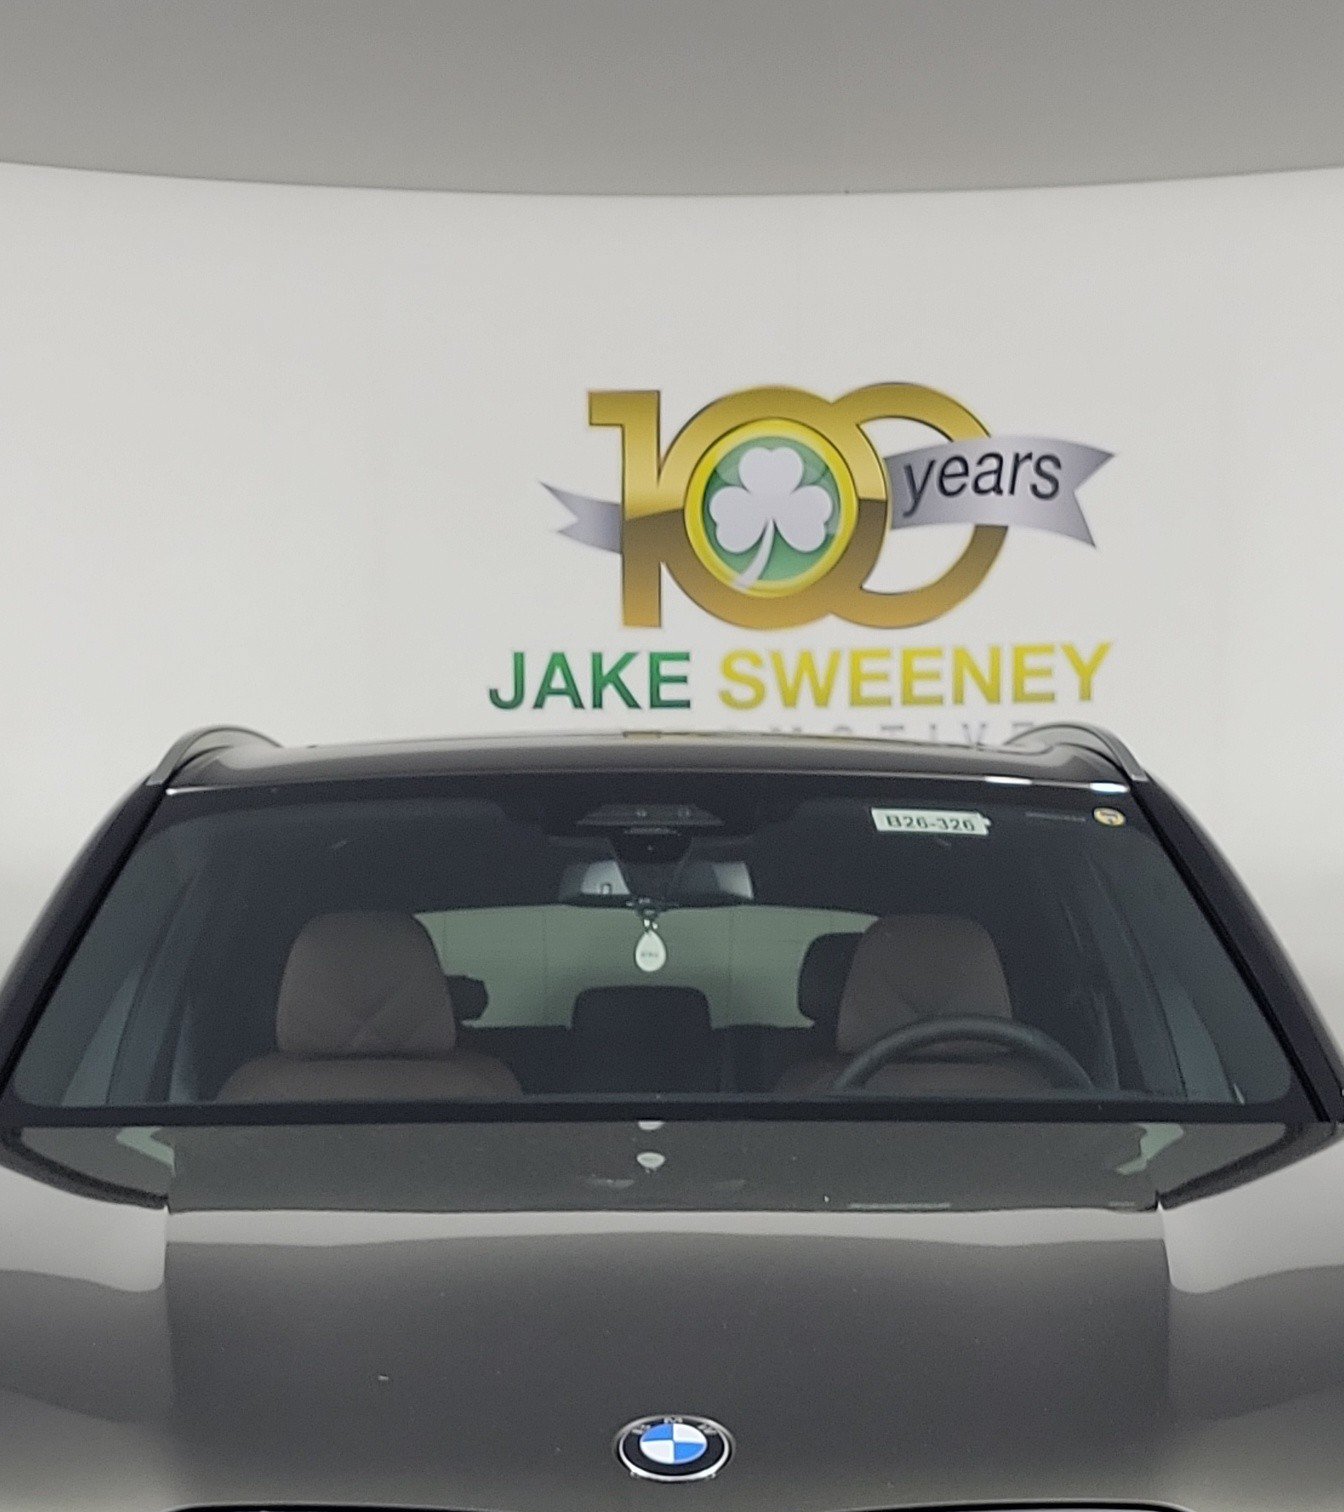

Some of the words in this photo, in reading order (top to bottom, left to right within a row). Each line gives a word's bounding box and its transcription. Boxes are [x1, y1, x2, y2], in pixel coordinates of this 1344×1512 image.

[588, 383, 1008, 630] 100
[903, 450, 1062, 517] years
[488, 651, 691, 710] JAKE
[717, 642, 1111, 710] SWEENEY
